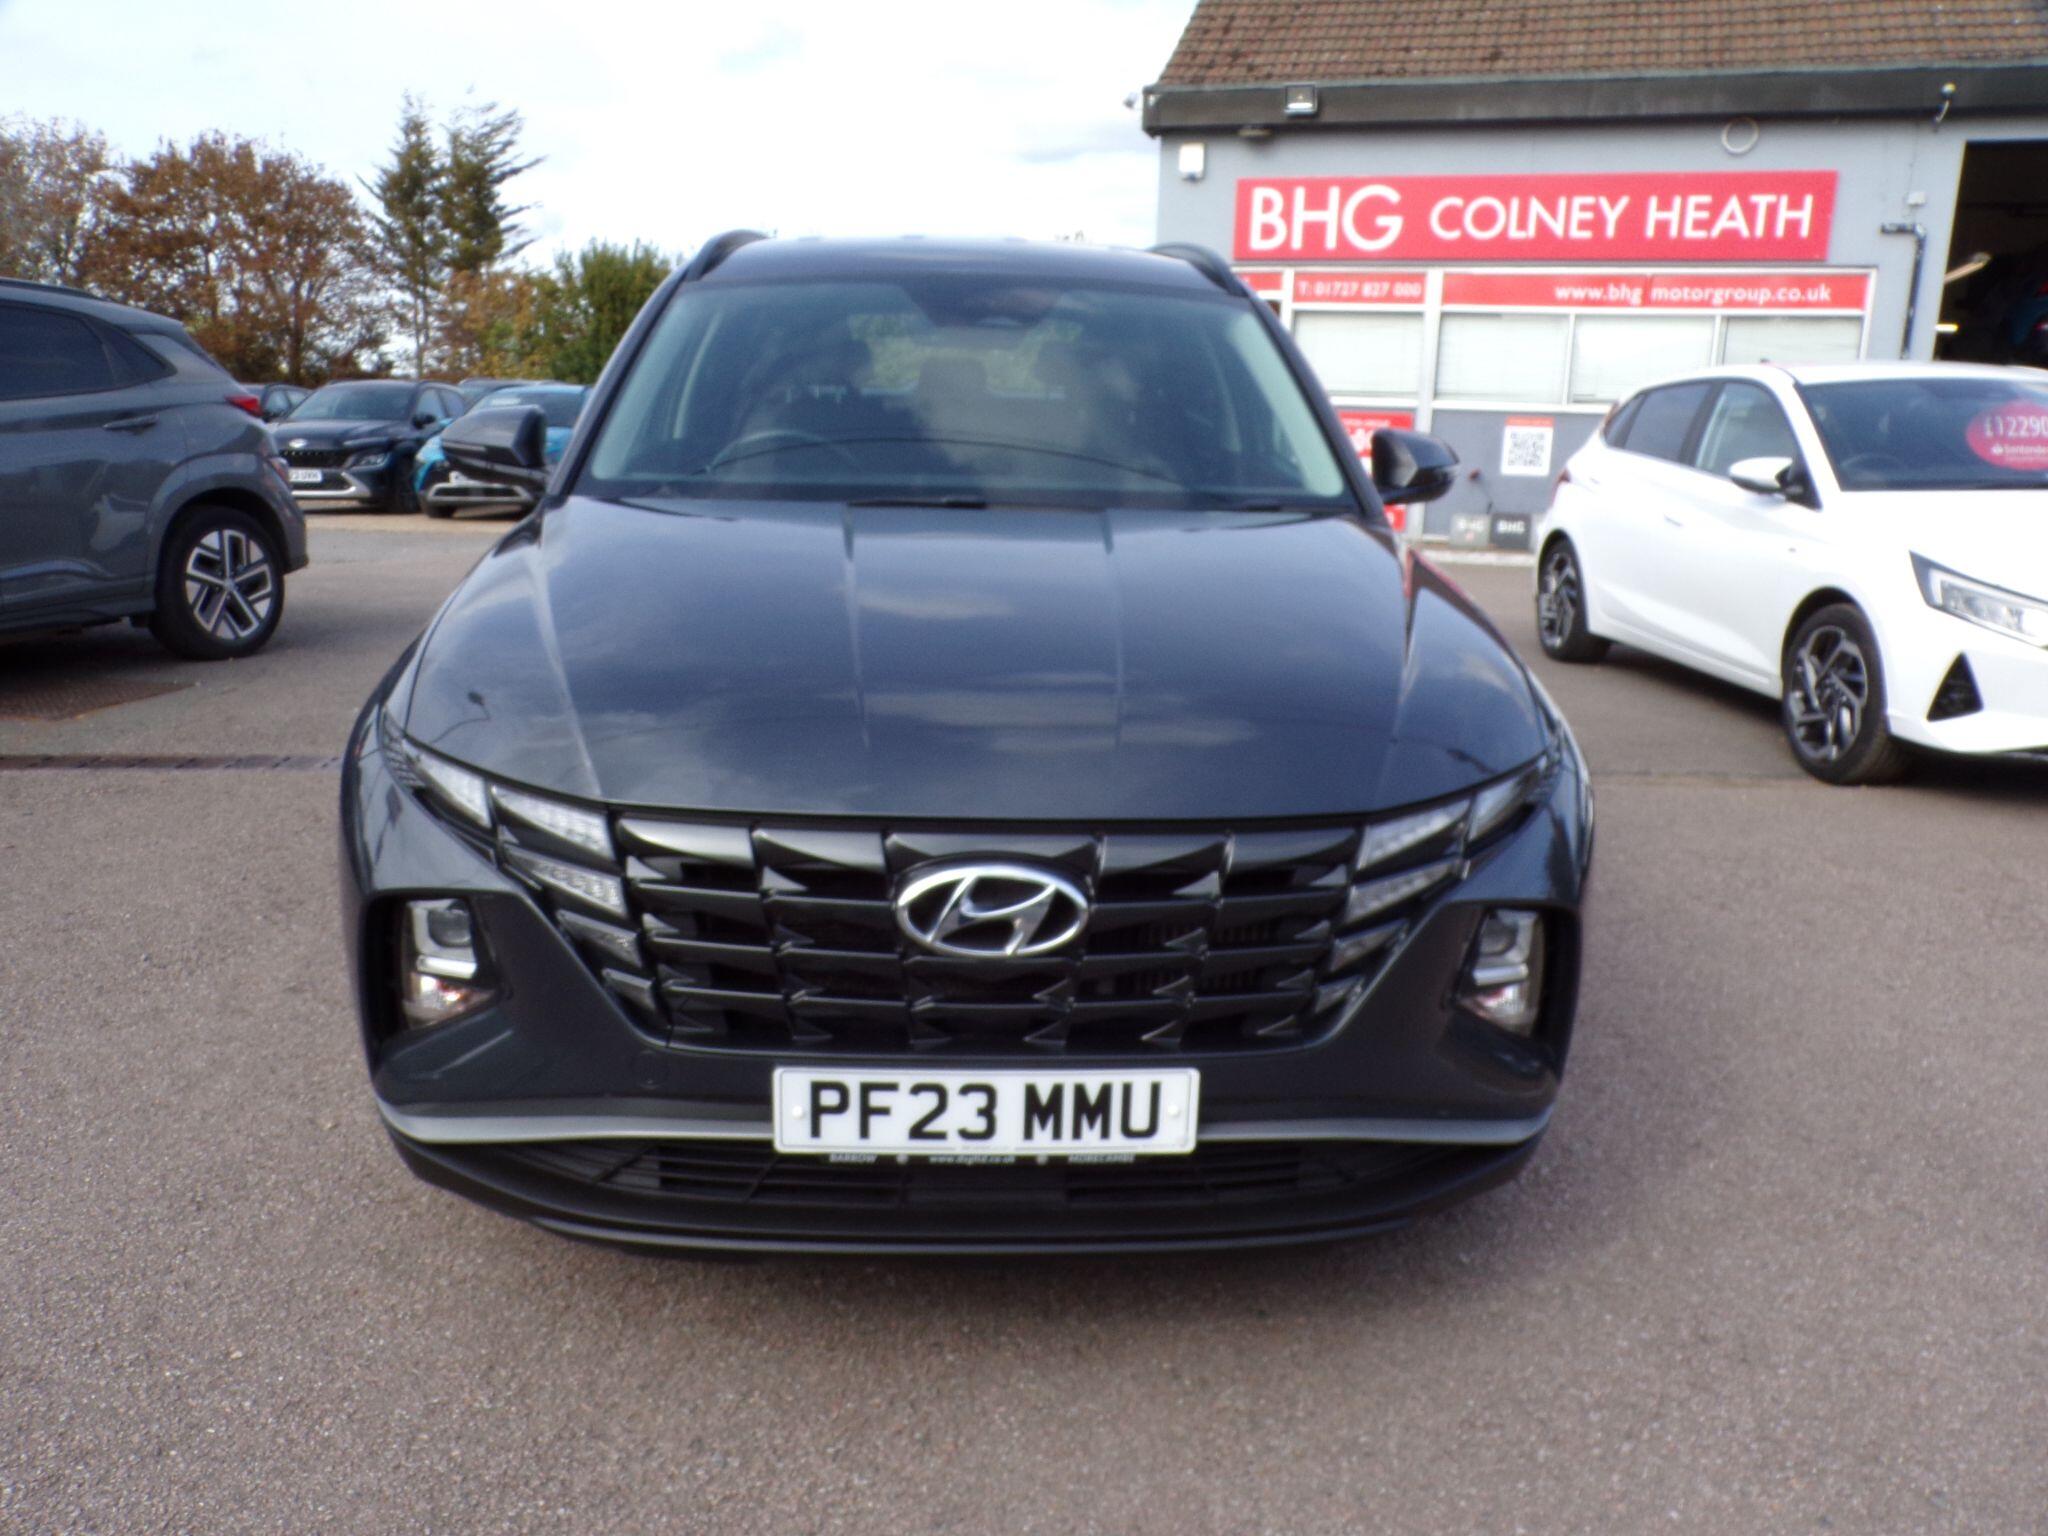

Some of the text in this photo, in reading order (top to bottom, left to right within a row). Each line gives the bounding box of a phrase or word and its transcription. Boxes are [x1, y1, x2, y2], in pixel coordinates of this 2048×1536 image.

[1249, 185, 1814, 252] BHG COLNEY HEATH
[808, 1080, 1163, 1141] PF23 MMU
